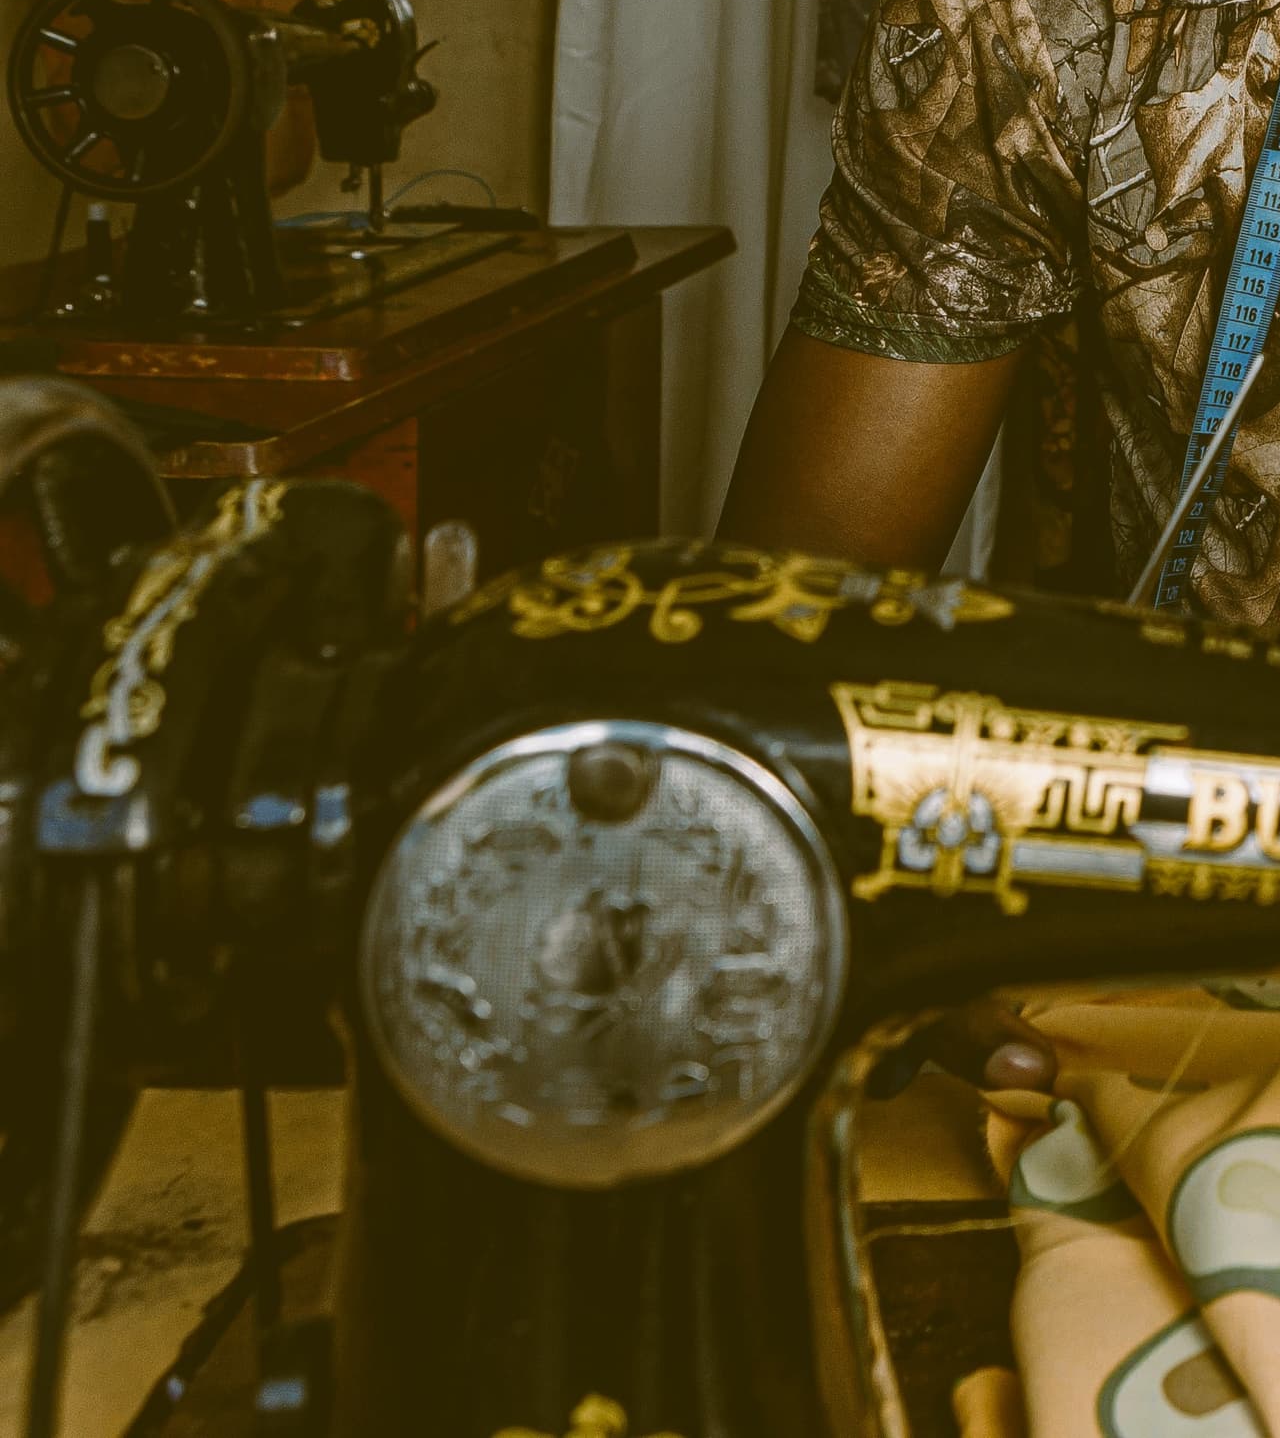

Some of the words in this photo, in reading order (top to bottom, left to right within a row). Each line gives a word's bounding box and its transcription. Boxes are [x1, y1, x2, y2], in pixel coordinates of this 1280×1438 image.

[1255, 219, 1280, 238] 113
[1249, 248, 1273, 266] 114
[1241, 276, 1265, 295] 115
[1234, 305, 1257, 323] 116
[1227, 332, 1250, 350] 117
[1220, 360, 1241, 379] 118
[1212, 388, 1234, 406] 119
[1178, 529, 1195, 545] 124
[1172, 557, 1188, 573] 125
